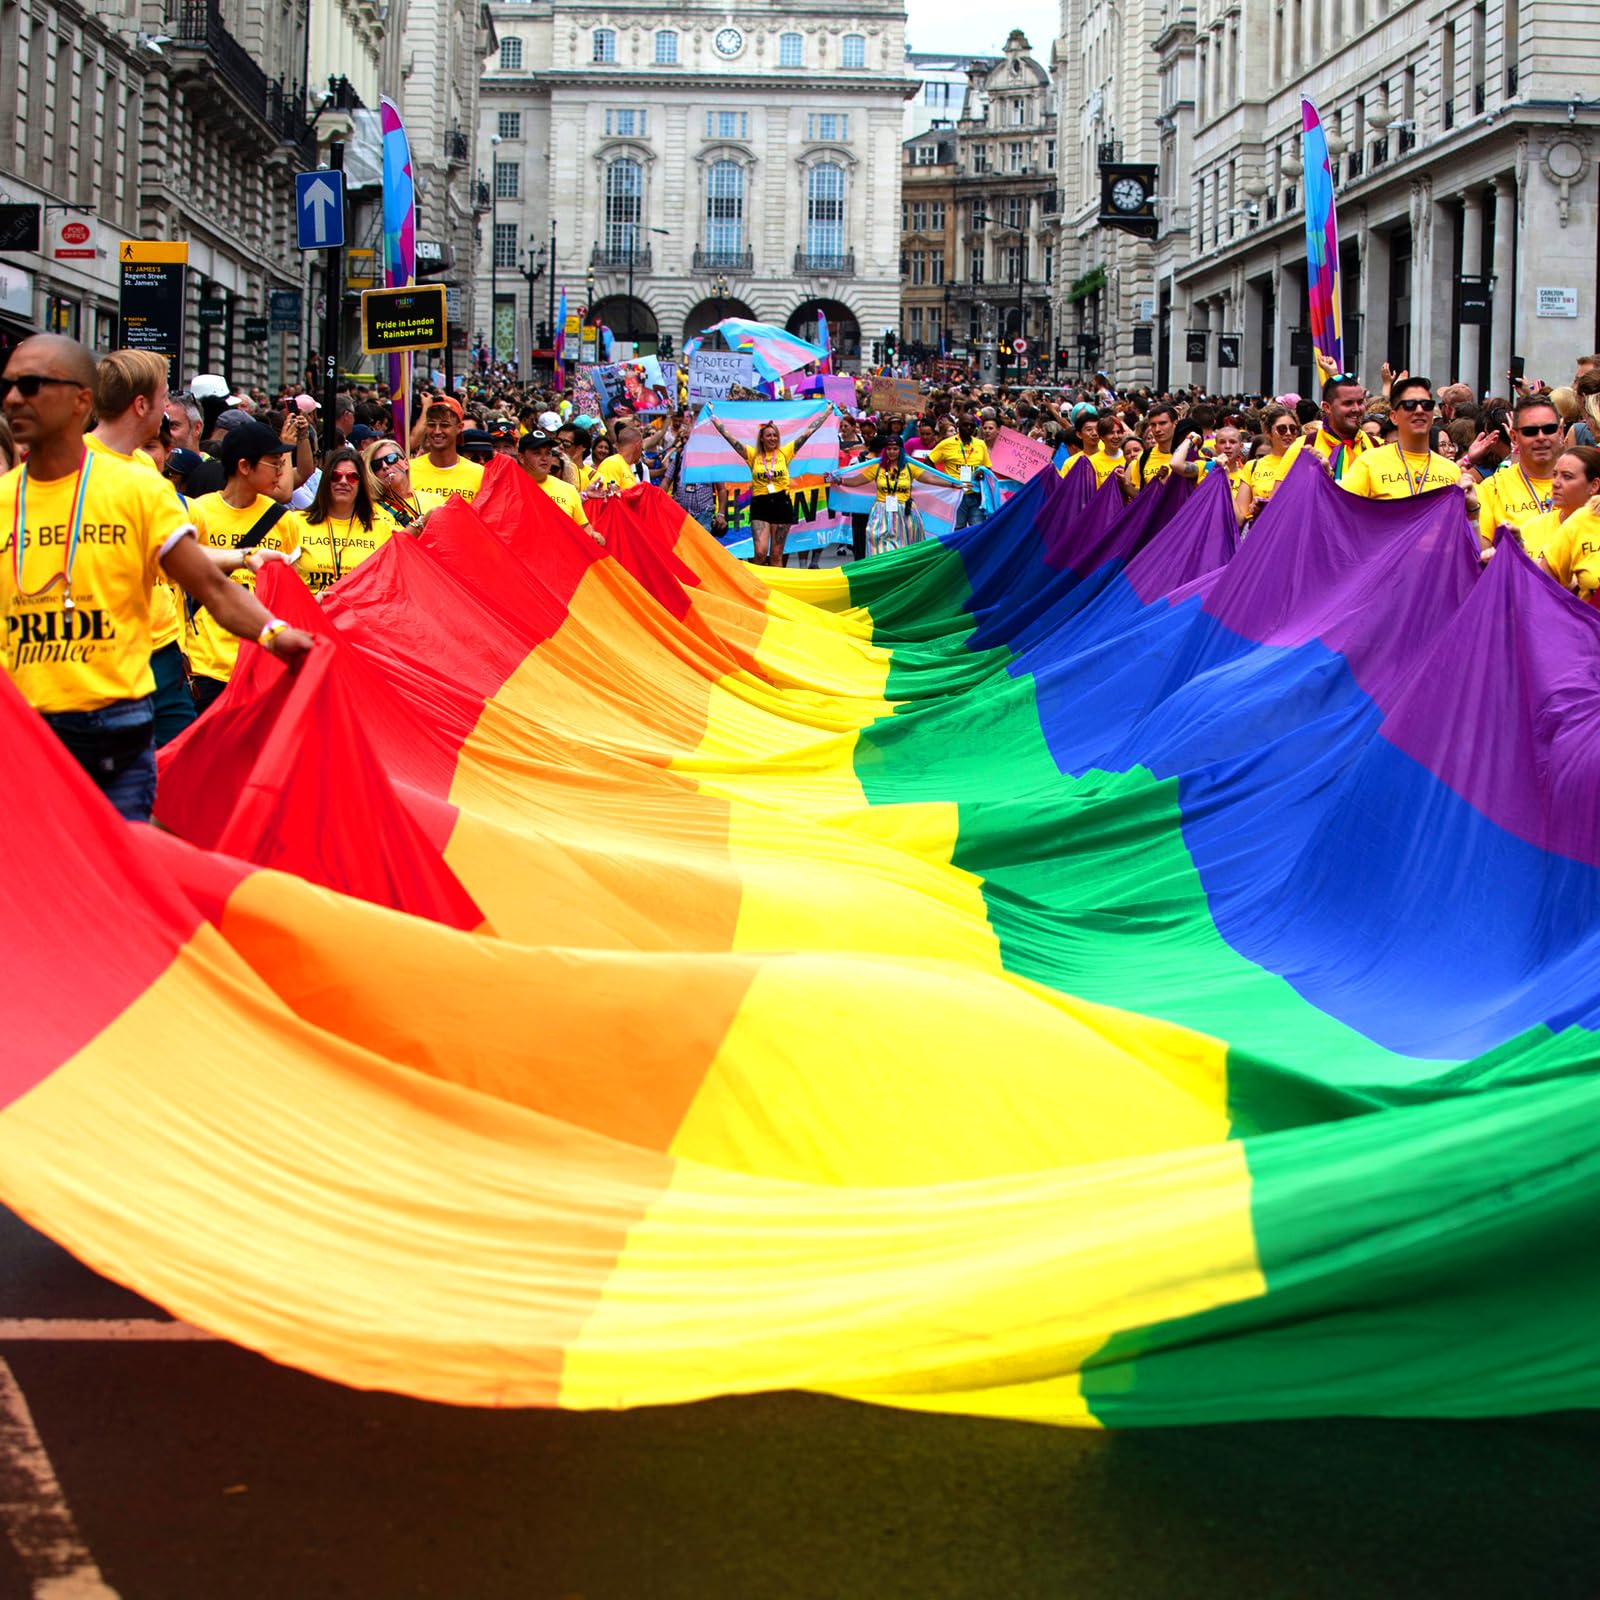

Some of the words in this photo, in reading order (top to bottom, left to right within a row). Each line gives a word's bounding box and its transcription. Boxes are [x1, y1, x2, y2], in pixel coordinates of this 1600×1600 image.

[415, 242, 442, 259] NEMA
[376, 321, 397, 329] Pride
[407, 318, 435, 327] London
[383, 330, 416, 339] Rainbow
[417, 328, 433, 336] Flag
[696, 356, 743, 369] PROTECT
[326, 368, 335, 378] 4
[695, 372, 741, 384] TRANS
[1017, 460, 1028, 469] IS
[1005, 464, 1027, 479] REAL
[1254, 471, 1275, 479] FLAG
[1420, 474, 1456, 487] EARE
[1505, 501, 1538, 513] FLAG
[0, 529, 32, 554] AG
[39, 524, 127, 545] BERER
[209, 534, 227, 546] AG
[231, 534, 282, 551] BERER
[302, 536, 331, 546] FLAG
[334, 537, 376, 550] BEARER
[6, 609, 116, 646] PRIDE
[14, 637, 96, 672] Jubilee
